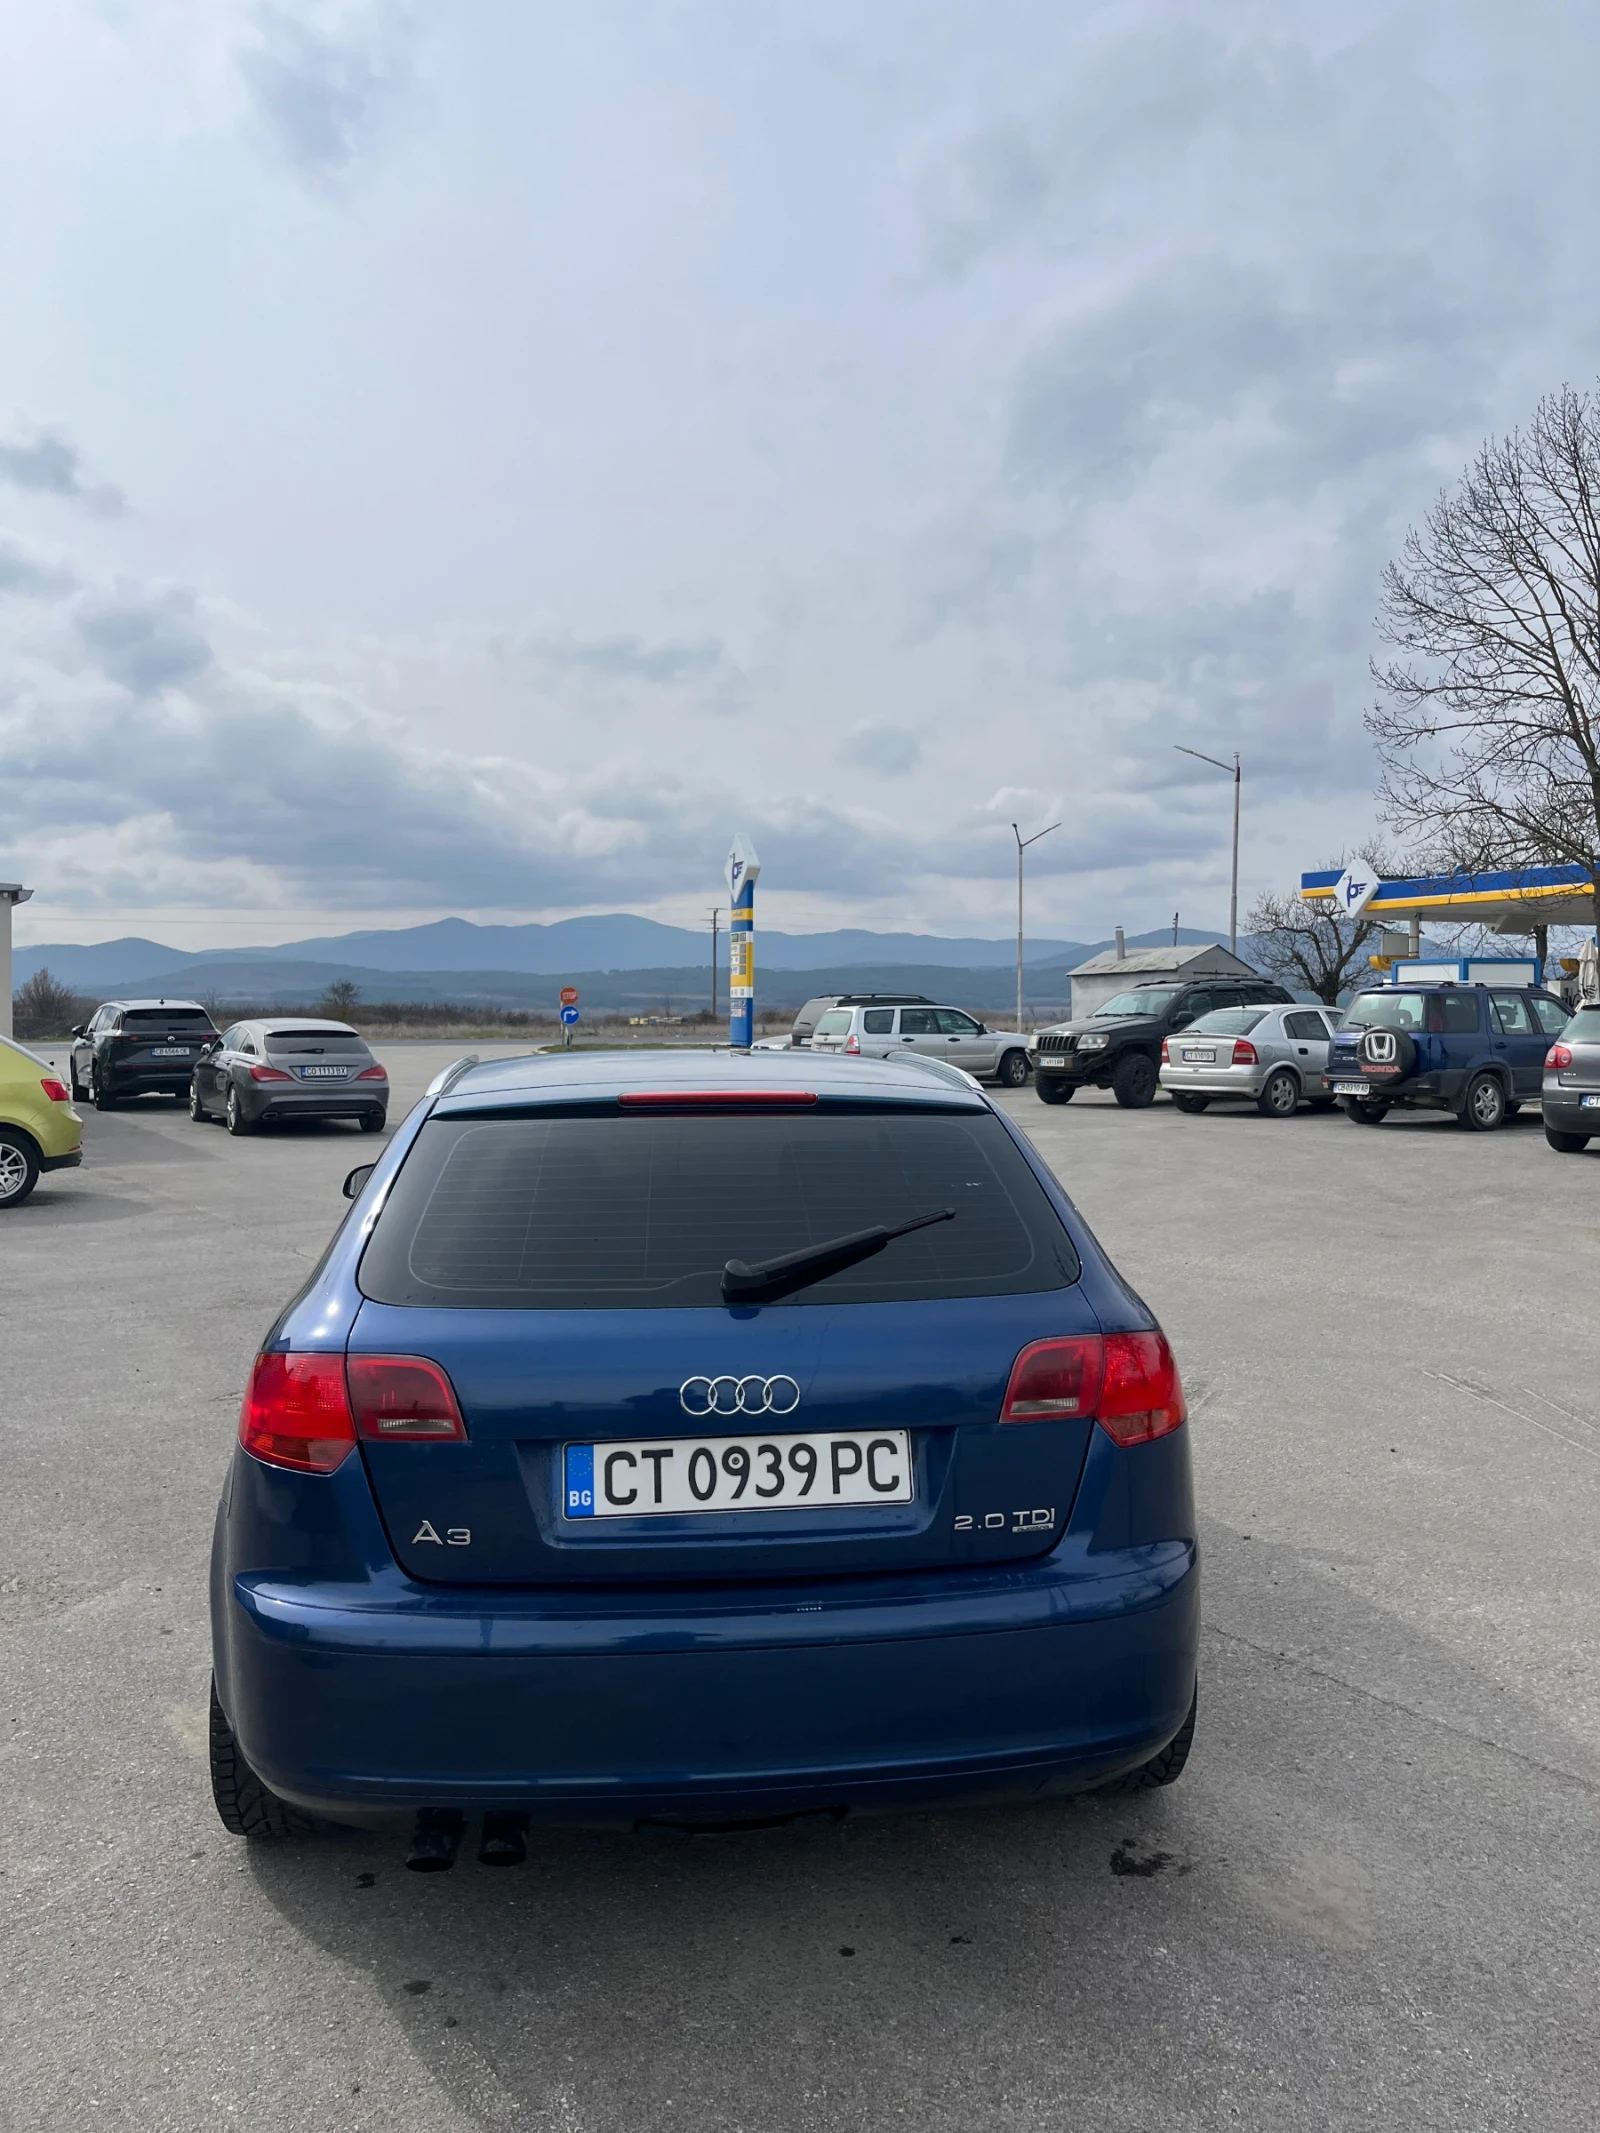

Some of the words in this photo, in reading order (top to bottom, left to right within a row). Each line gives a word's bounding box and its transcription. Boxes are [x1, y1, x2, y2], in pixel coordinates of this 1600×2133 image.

[562, 991, 577, 1000] STOP
[318, 1067, 335, 1075] 1113
[1360, 1065, 1402, 1073] HONDA
[1345, 1084, 1361, 1092] 0310
[604, 1449, 673, 1506] CT
[688, 1442, 818, 1502] 0939
[830, 1439, 900, 1495] PC
[569, 1490, 592, 1507] BG
[954, 1513, 1005, 1530] 2.0
[1012, 1508, 1055, 1525] TDI
[411, 1520, 471, 1546] A3
